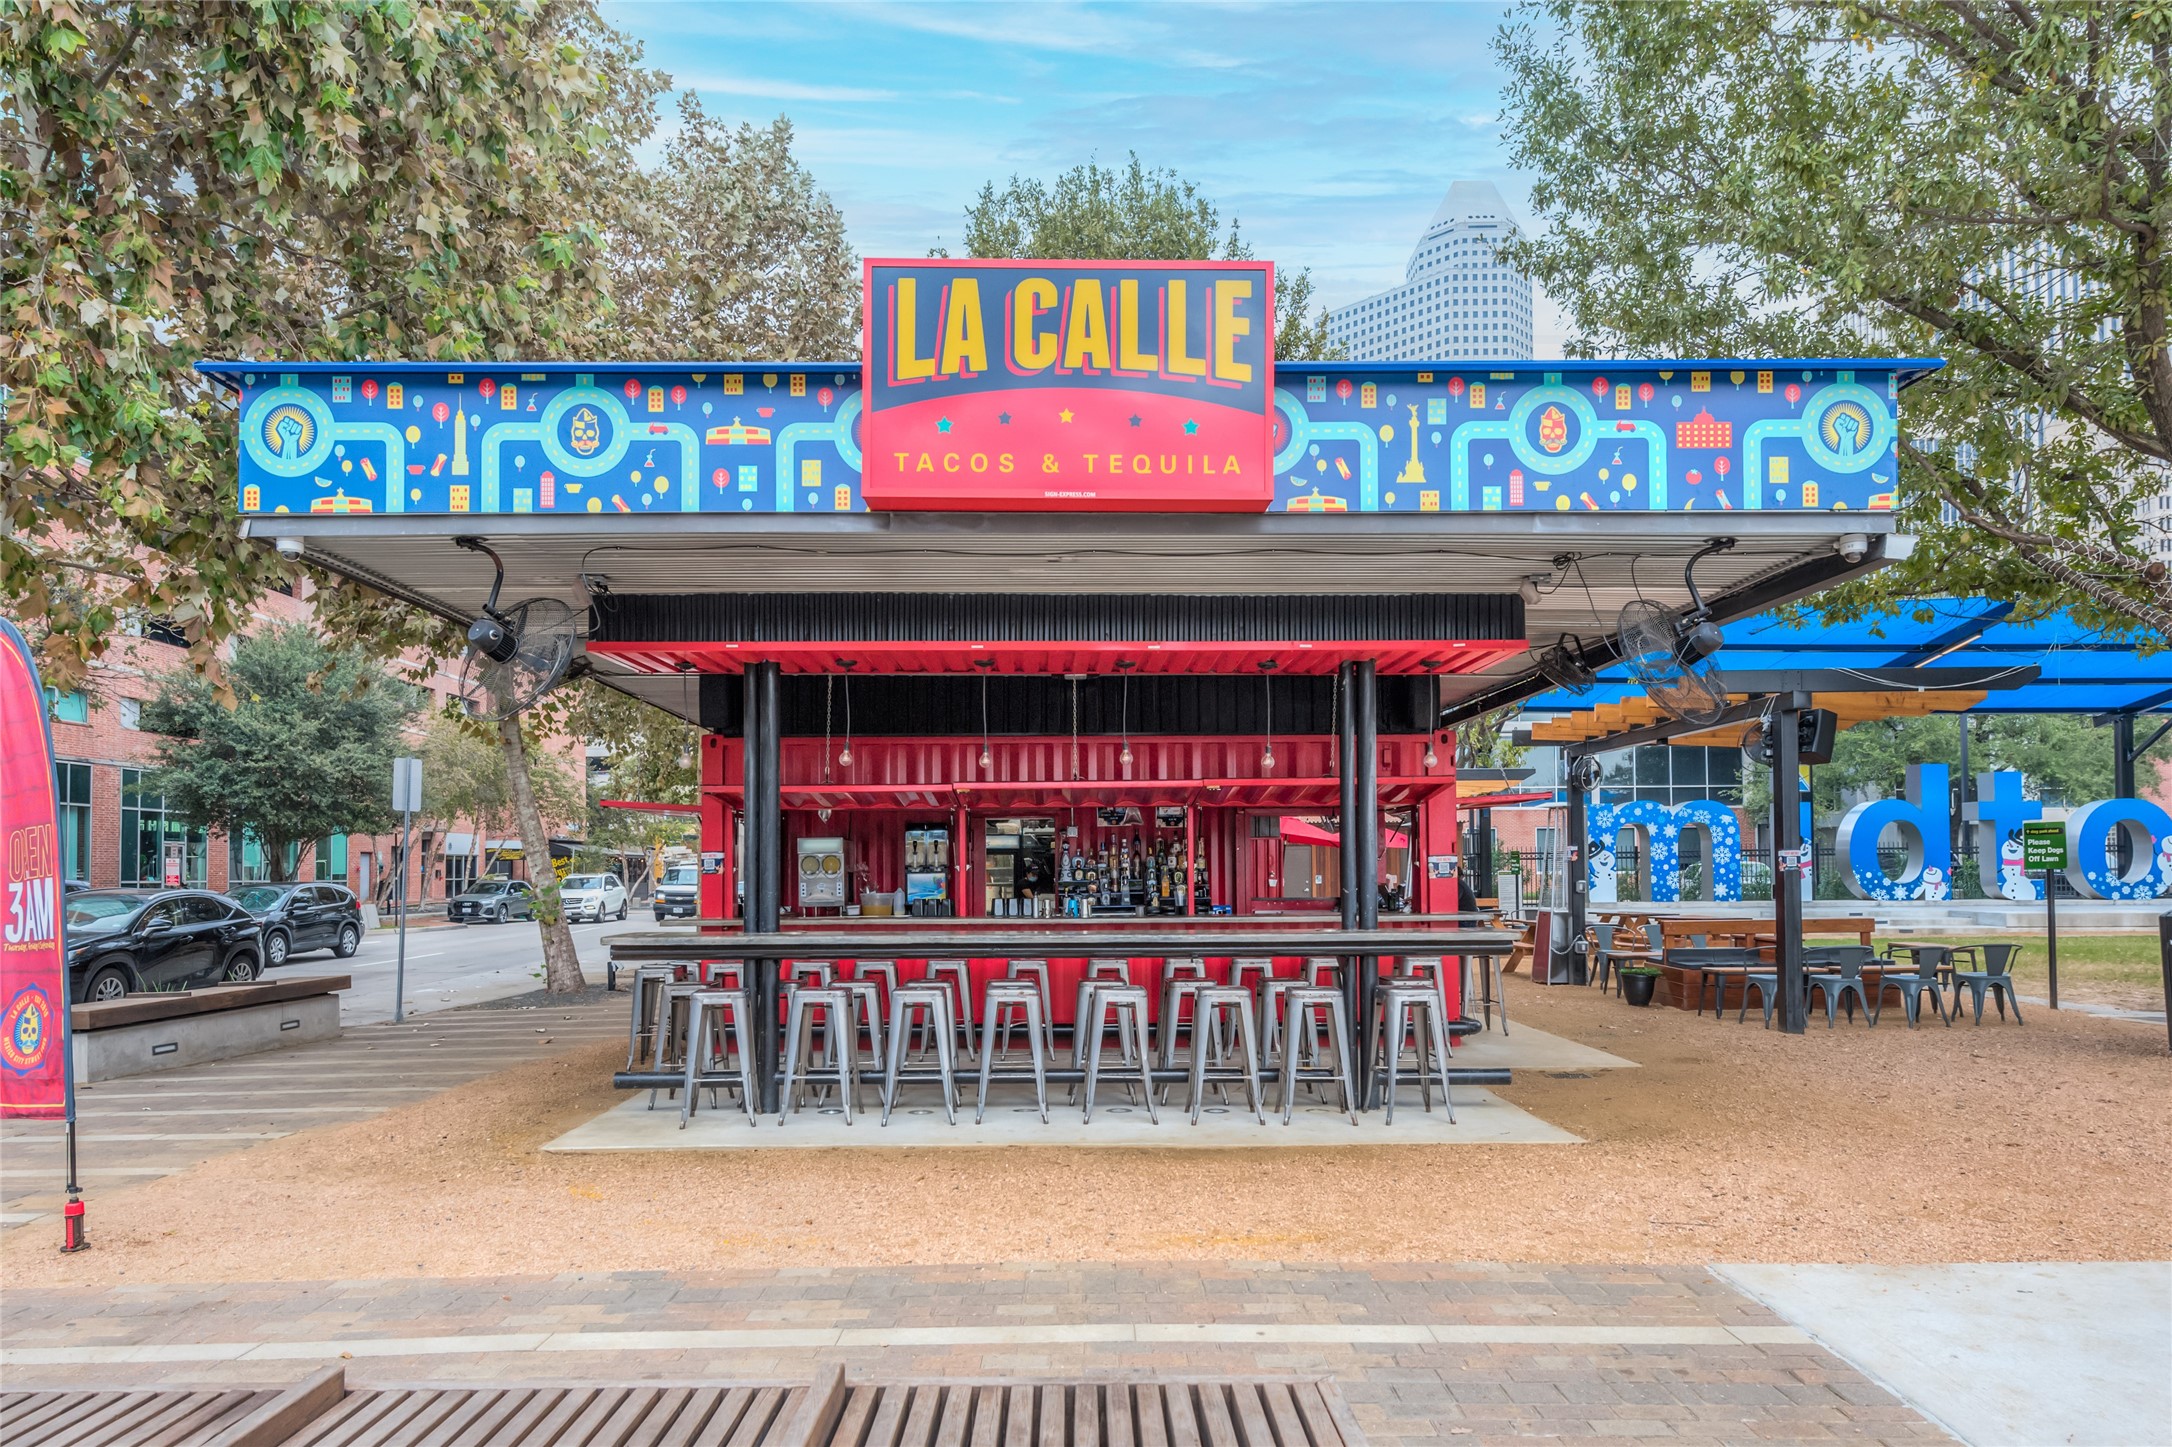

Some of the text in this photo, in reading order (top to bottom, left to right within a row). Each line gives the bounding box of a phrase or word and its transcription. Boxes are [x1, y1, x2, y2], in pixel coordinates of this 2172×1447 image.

[888, 278, 1253, 389] LA CALLE
[894, 452, 1241, 475] TACOS & TEQUILA
[551, 856, 568, 868] Best
[5, 877, 54, 944] 3AM
